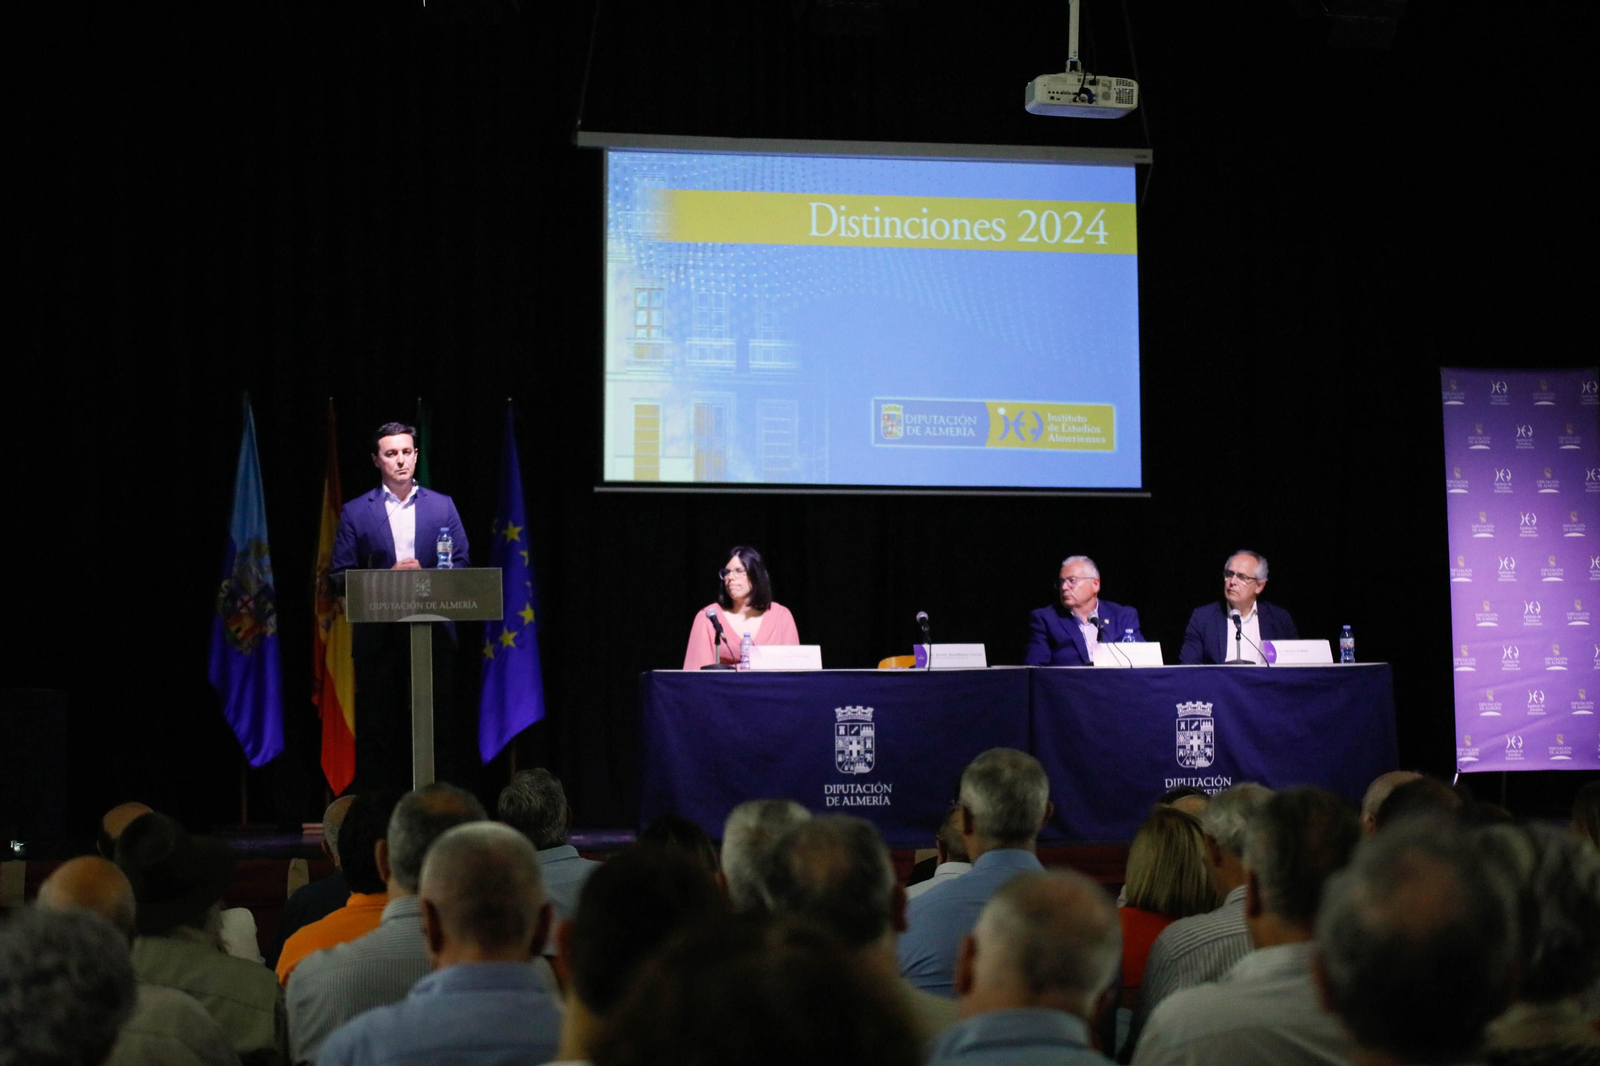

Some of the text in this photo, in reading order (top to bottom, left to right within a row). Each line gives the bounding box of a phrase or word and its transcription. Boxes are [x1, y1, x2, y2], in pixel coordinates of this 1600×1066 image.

[808, 201, 1109, 245] Distinciones 2024
[905, 413, 978, 426] DIPUTACIÓN
[1047, 412, 1087, 423] Instituto
[906, 426, 922, 436] DE
[1047, 423, 1102, 434] de Estudios
[369, 600, 478, 611] DIPUTACIÓN DE ALMERÍA
[824, 781, 892, 794] DIPUTACIÓN
[1165, 775, 1232, 788] DIPUTACIÓN
[826, 793, 891, 806] DE ALMERÍA
